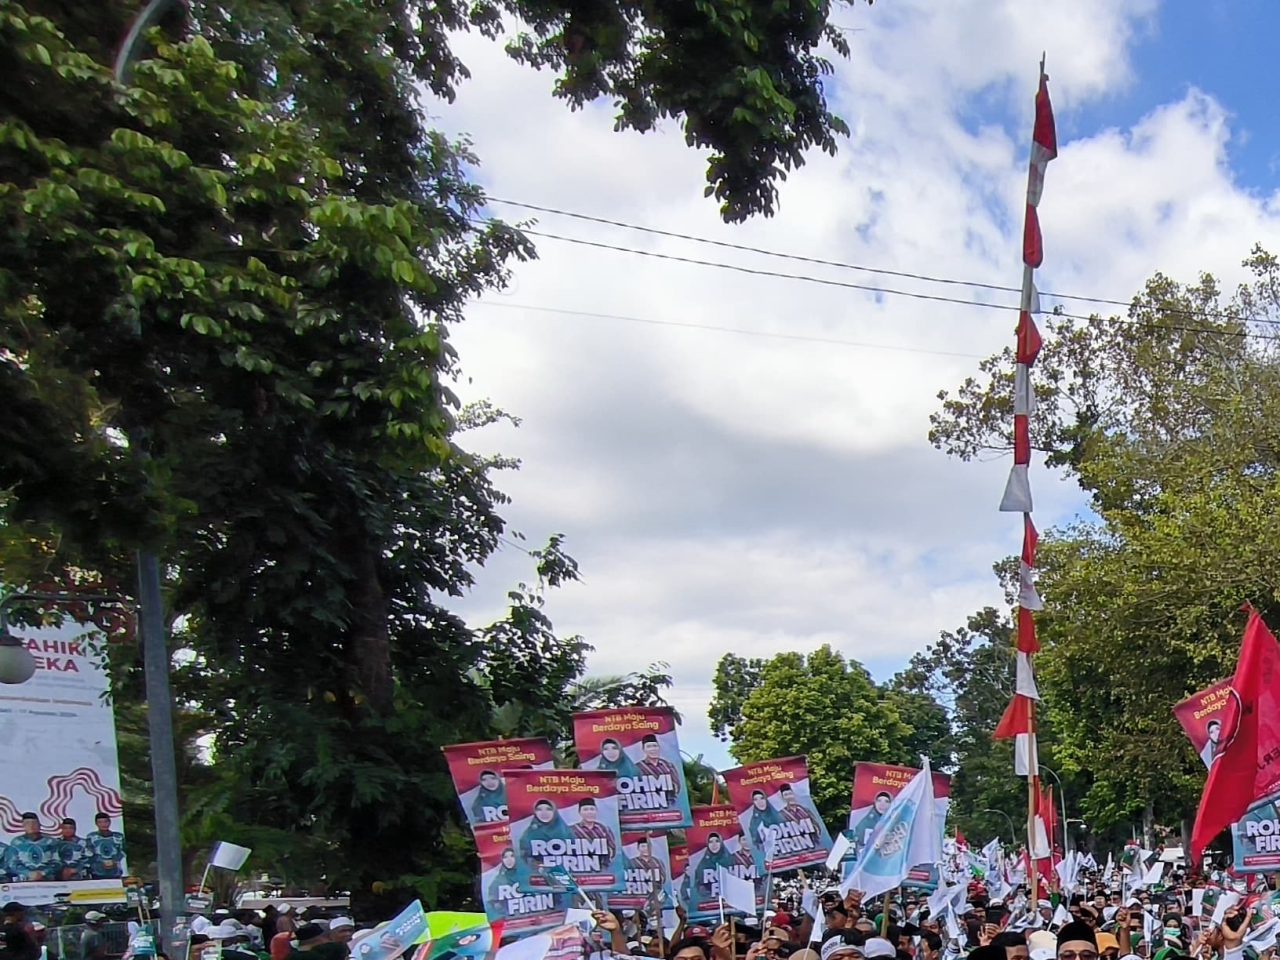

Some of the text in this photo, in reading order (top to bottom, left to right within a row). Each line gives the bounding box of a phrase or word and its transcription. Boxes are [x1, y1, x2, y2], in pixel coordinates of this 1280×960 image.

[592, 721, 659, 732] Berdaya Saing
[540, 776, 585, 785] NTB Maju
[616, 774, 674, 793] OHMI
[526, 784, 600, 794] Berdaya Saing
[530, 838, 608, 856] ROHMI
[507, 893, 554, 915] FIRIN
